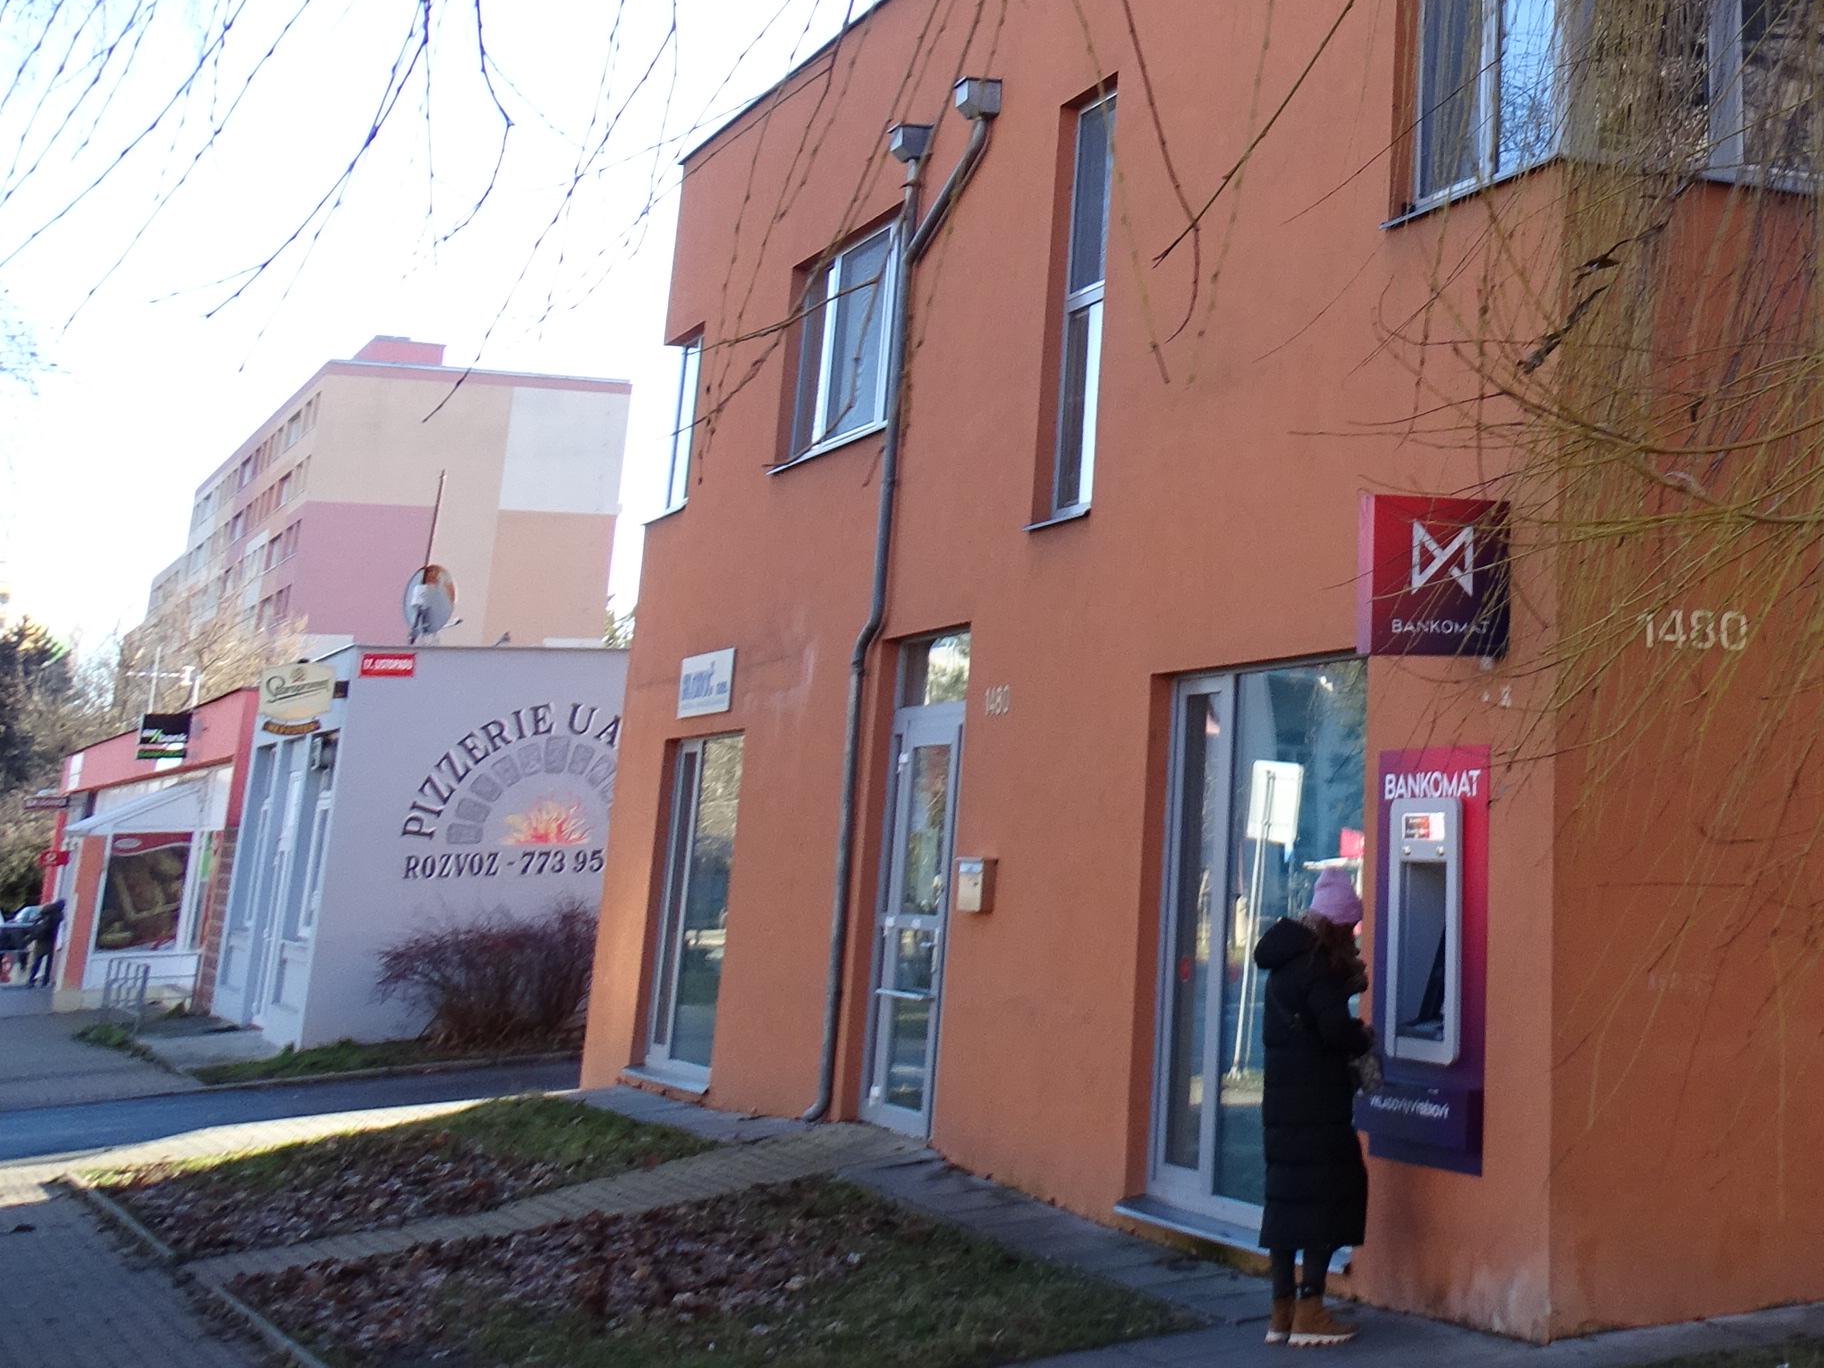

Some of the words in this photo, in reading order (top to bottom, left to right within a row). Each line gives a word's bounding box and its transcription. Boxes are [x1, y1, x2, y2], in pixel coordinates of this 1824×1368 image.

[1391, 618, 1490, 634] BANKOMAT
[1646, 609, 1748, 651] 1480
[401, 702, 554, 841] PIZZERIE
[1384, 768, 1481, 800] BANKOMAT
[402, 851, 500, 880] ROZVOZ
[519, 849, 566, 876] 773
